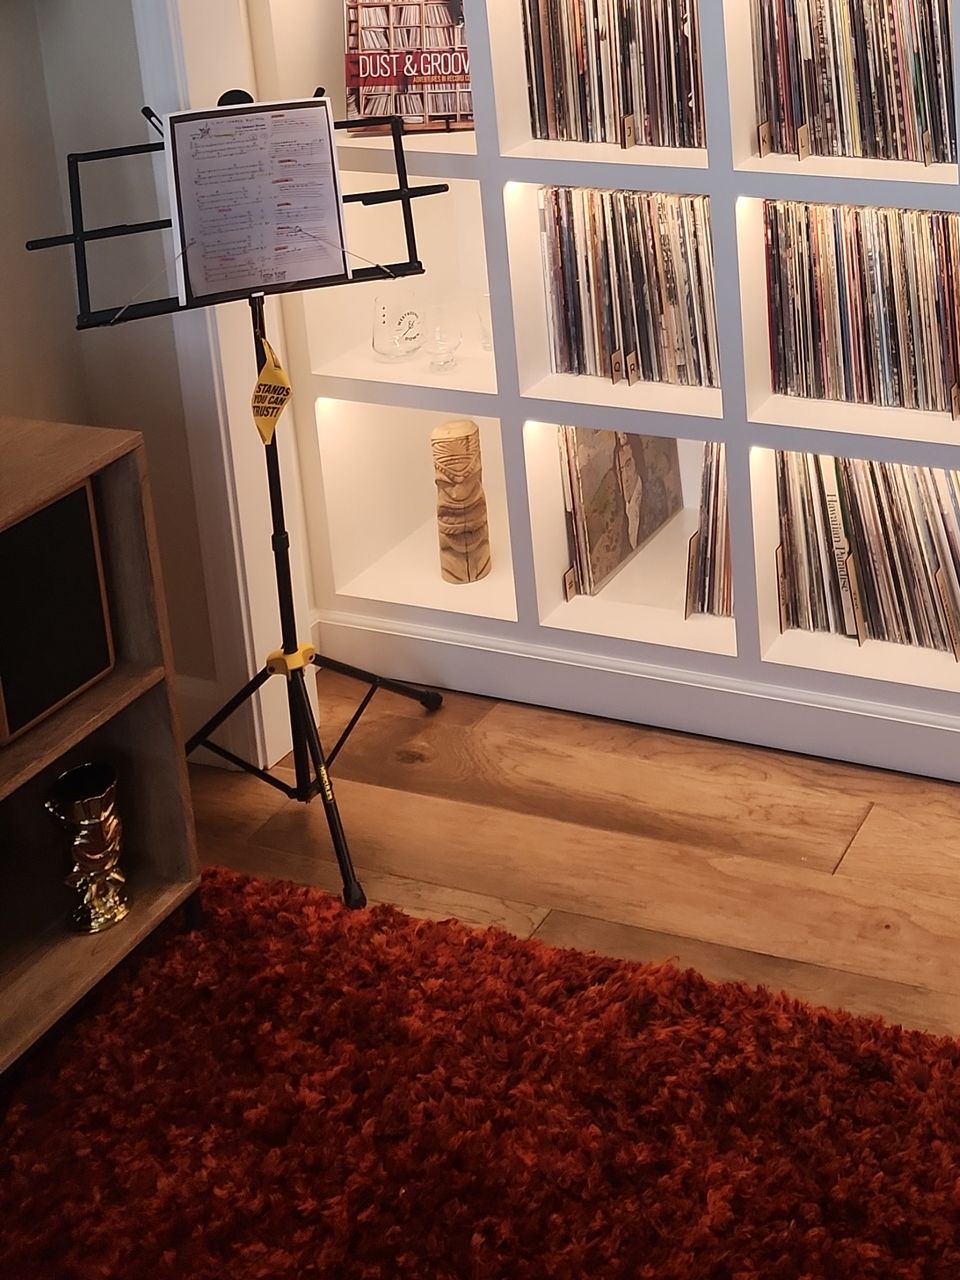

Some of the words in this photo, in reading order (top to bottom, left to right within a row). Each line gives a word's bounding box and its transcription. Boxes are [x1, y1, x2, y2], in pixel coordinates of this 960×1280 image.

[359, 54, 400, 77] DUST
[403, 54, 419, 76] &
[420, 52, 470, 76] GROOV
[627, 126, 632, 137] J
[762, 134, 768, 145] K
[631, 363, 636, 375] R
[256, 383, 291, 397] STANDS
[254, 394, 268, 404] YOU
[268, 395, 286, 405] CAN
[252, 405, 280, 418] TRUST!
[827, 494, 841, 543] Hawaiian
[835, 546, 848, 592] Paradise
